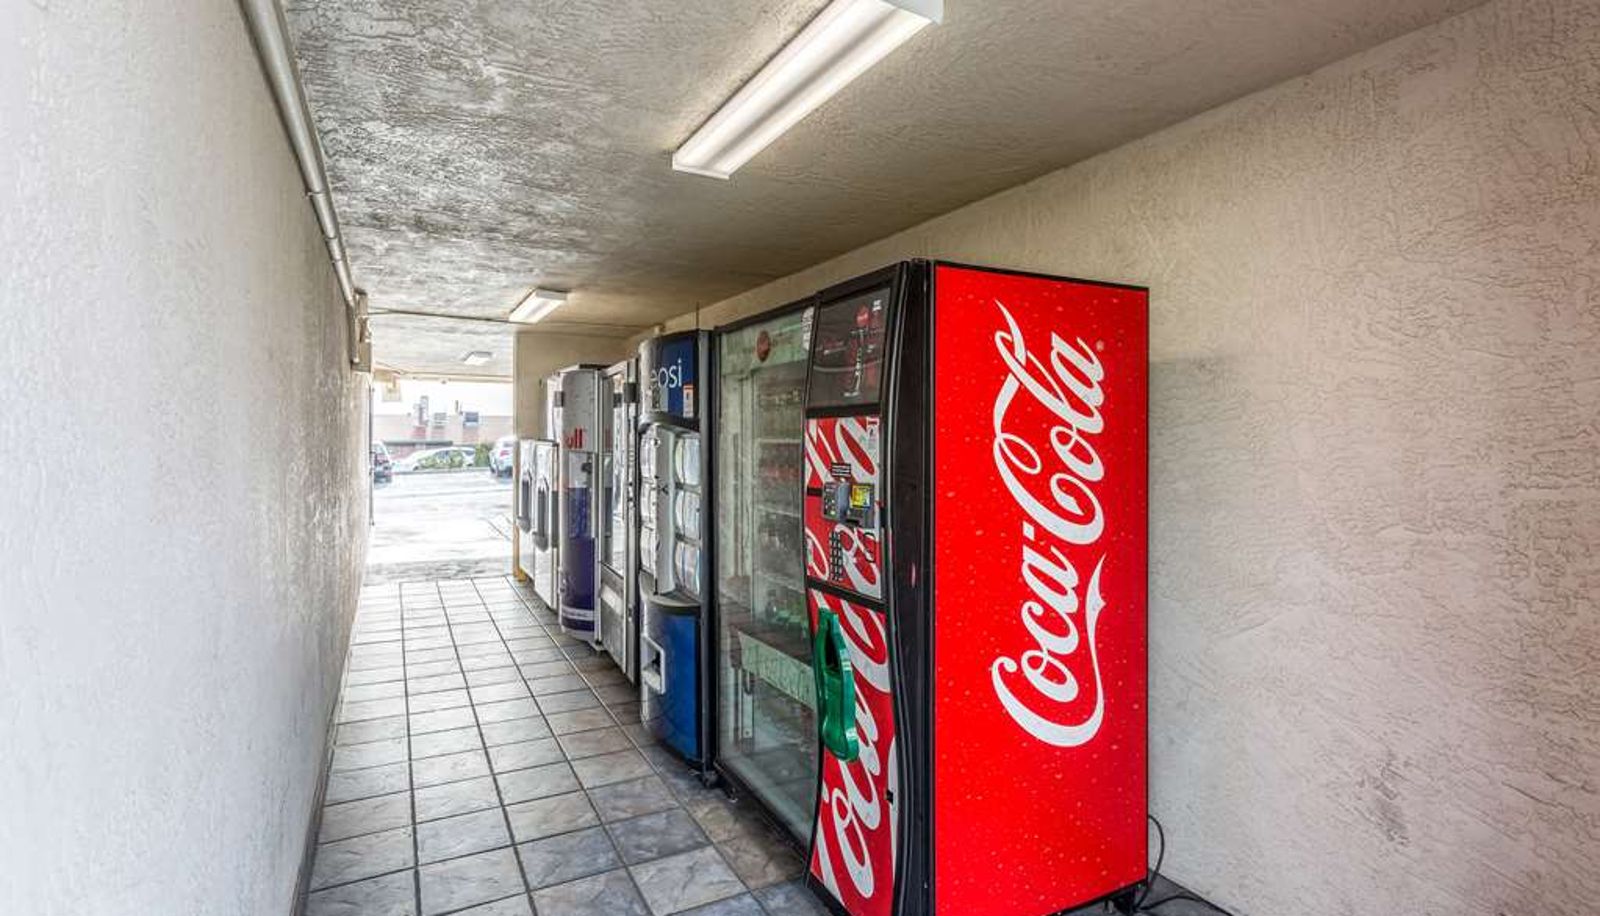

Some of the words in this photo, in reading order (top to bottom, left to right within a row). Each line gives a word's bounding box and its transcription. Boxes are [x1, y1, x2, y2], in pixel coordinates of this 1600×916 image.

[649, 357, 682, 389] epsi
[564, 427, 583, 450] ull
[991, 299, 1107, 747] Coca-Cola
